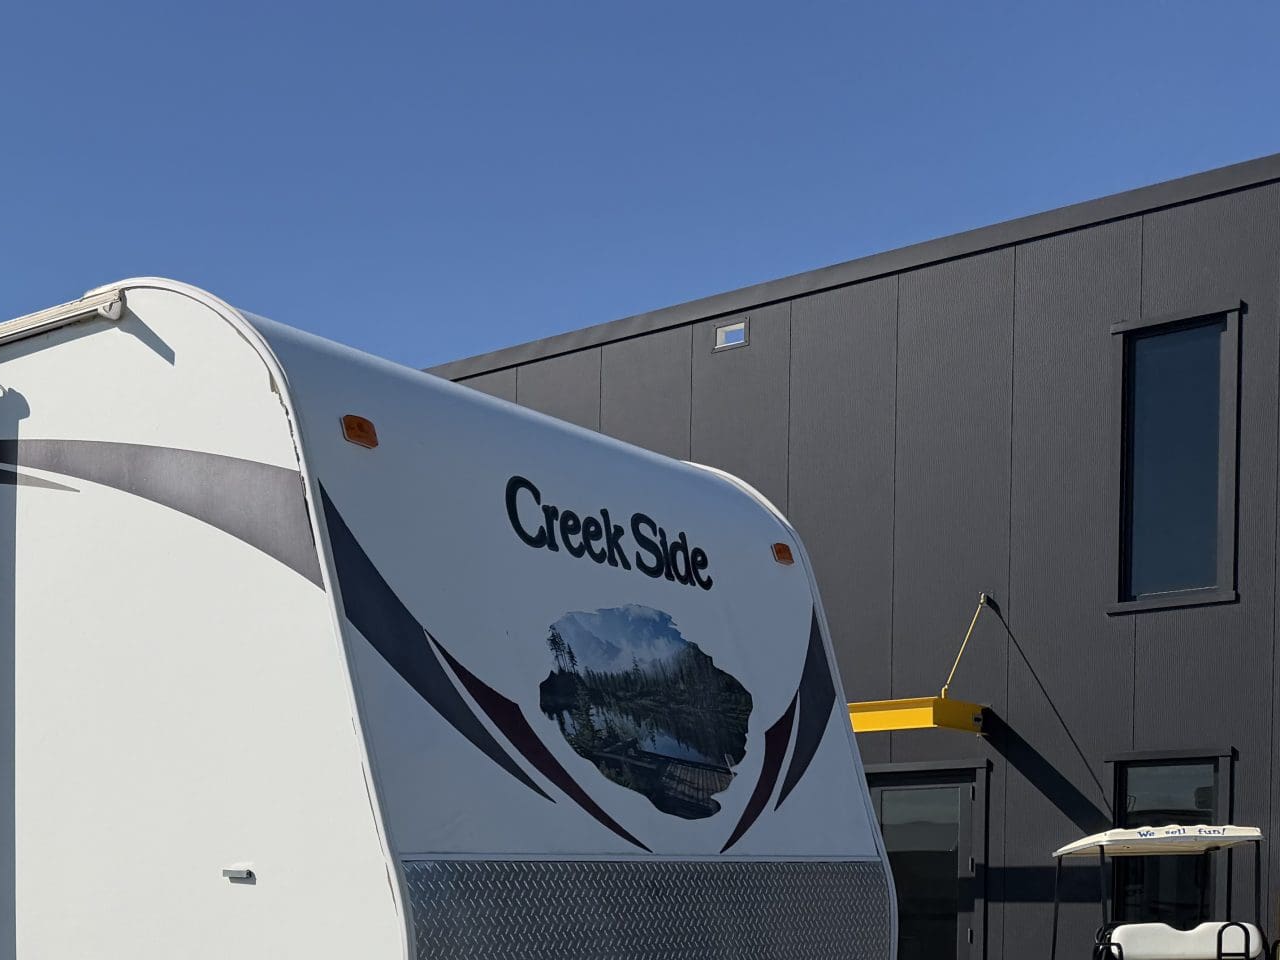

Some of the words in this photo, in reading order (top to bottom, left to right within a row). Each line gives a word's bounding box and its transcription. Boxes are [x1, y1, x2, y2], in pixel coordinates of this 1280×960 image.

[505, 475, 632, 571] Creek
[630, 512, 714, 591] Side
[1136, 830, 1156, 838] We
[1197, 827, 1227, 836] fun!
